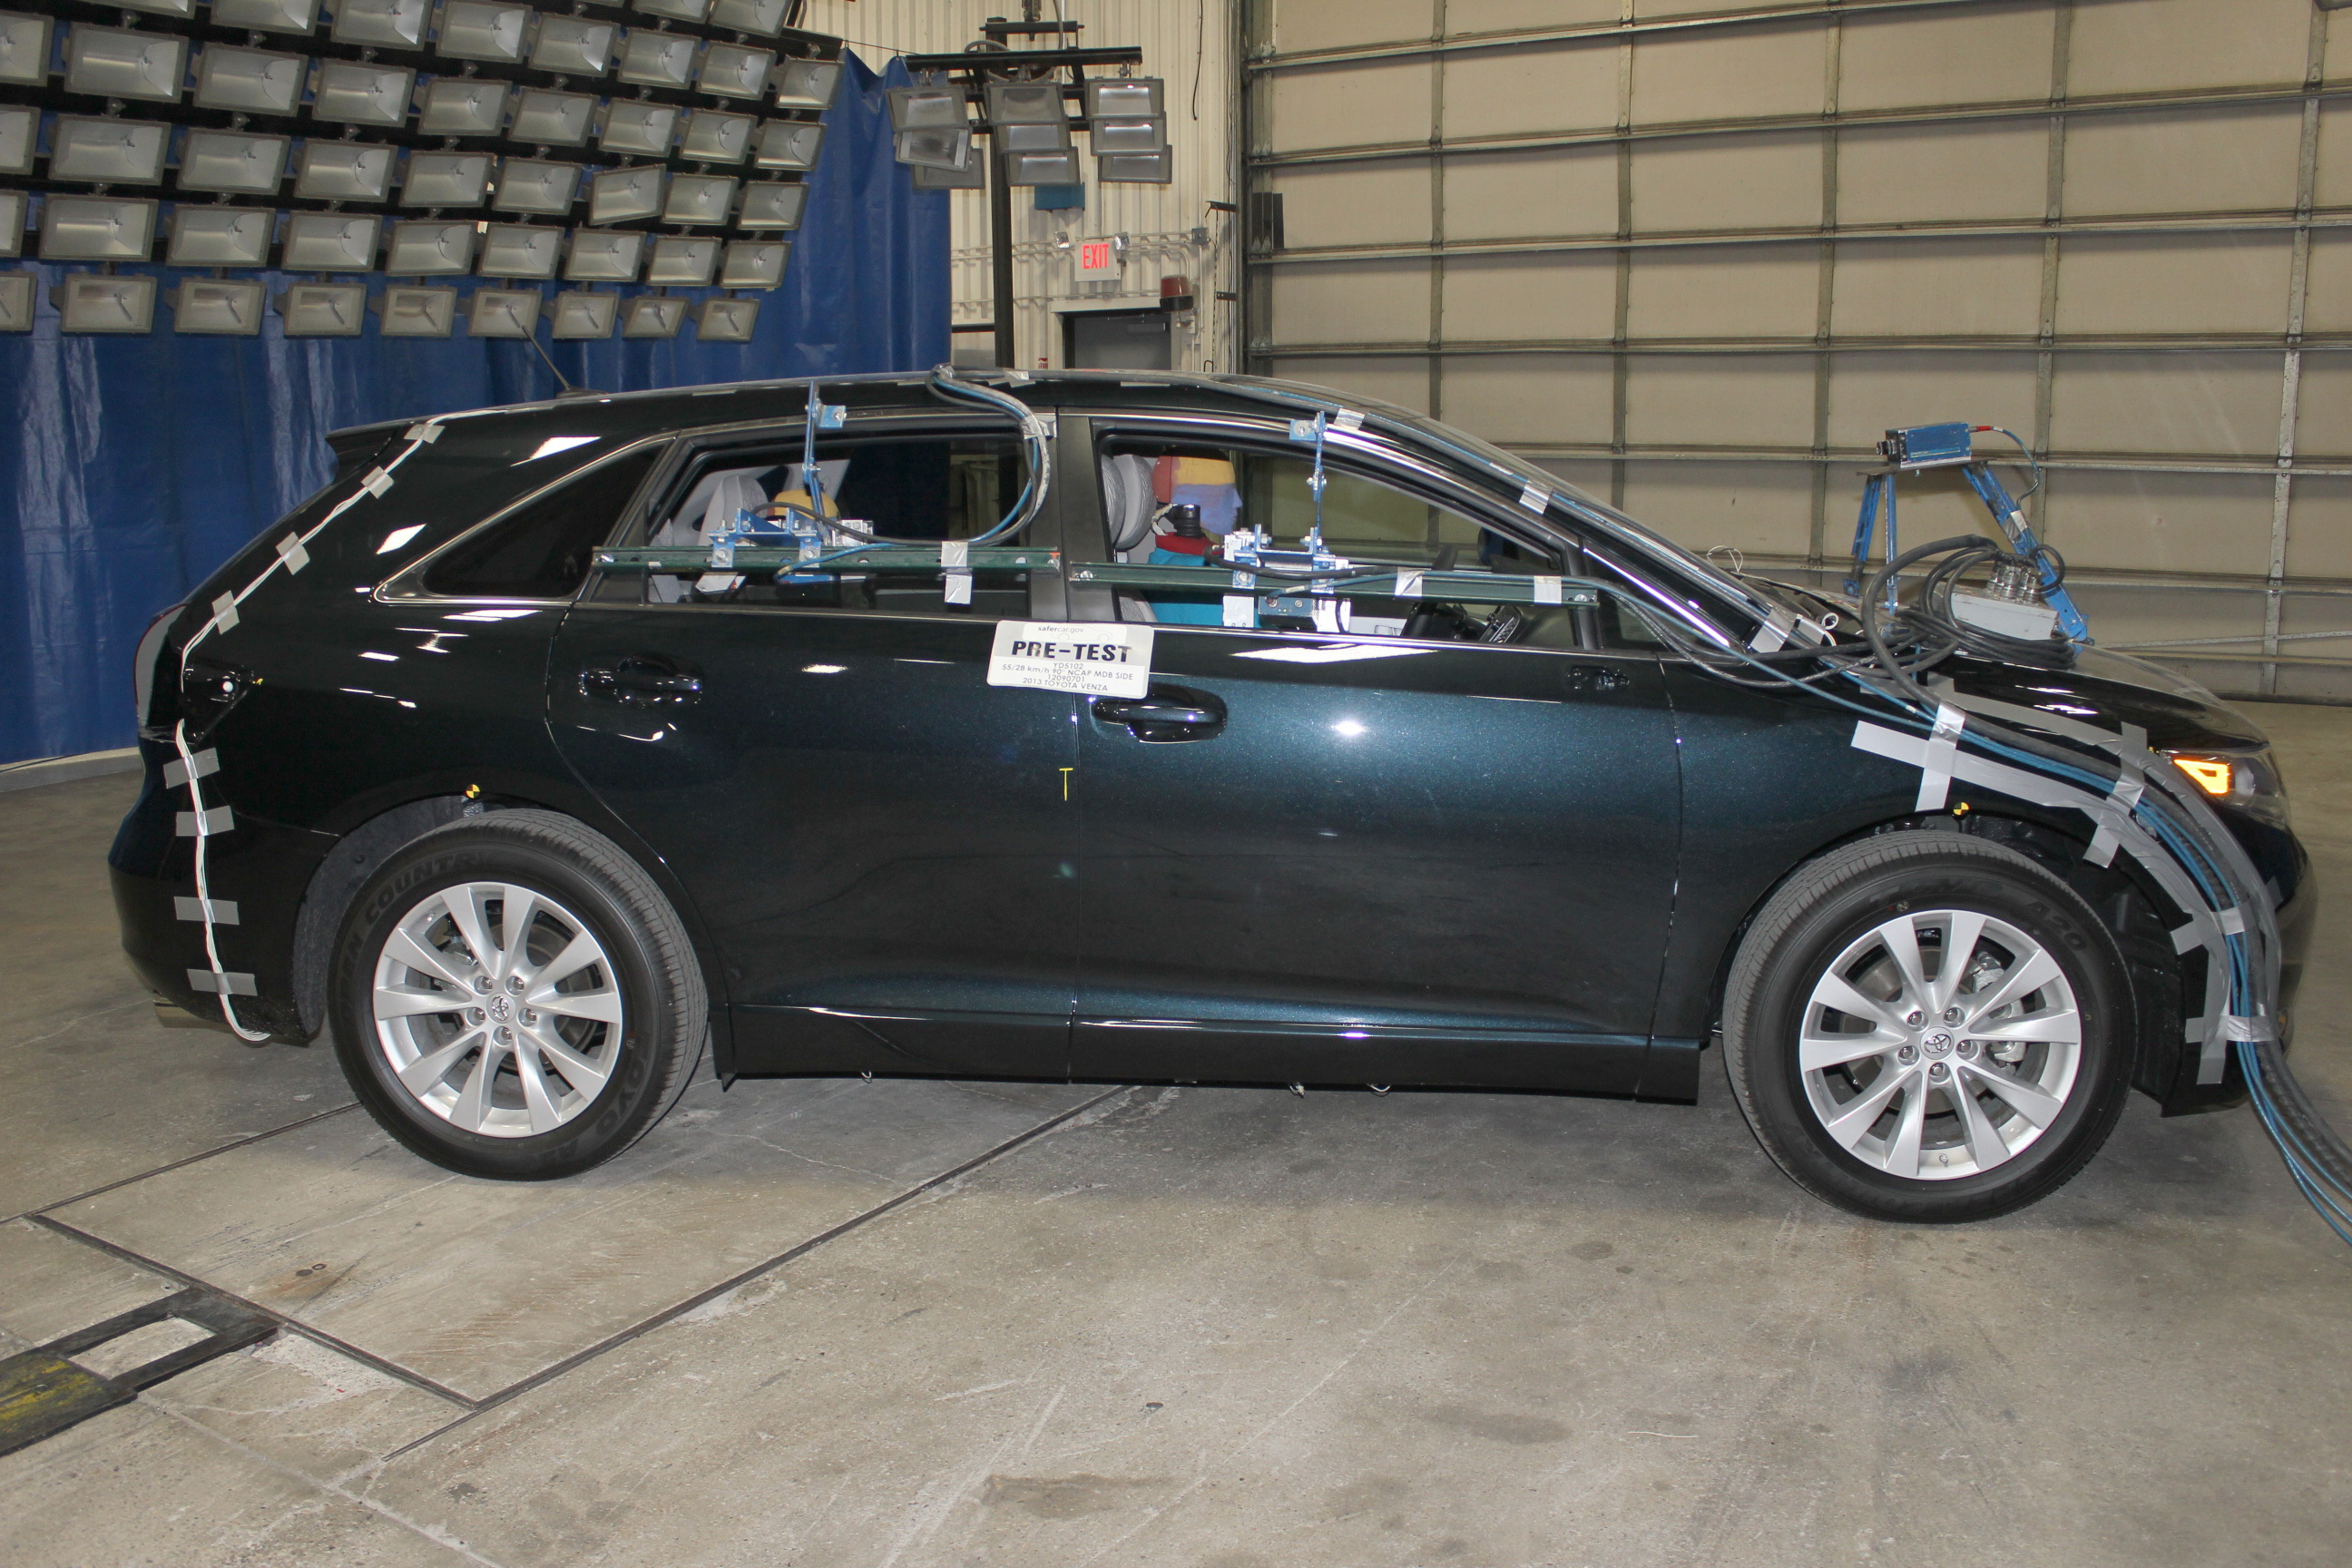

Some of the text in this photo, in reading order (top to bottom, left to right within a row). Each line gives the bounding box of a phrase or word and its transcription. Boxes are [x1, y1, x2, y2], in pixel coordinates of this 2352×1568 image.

[1082, 242, 1110, 270] EXIT
[1037, 625, 1085, 634] safercar.gov
[1011, 640, 1132, 662] PRE-TEST
[1002, 663, 1025, 671] 55/28
[1027, 665, 1050, 673] km/h
[1067, 669, 1092, 677] NCAP
[1093, 671, 1113, 679] MDB
[1115, 671, 1133, 681] SIDE
[1054, 662, 1083, 670] YD5102
[1023, 677, 1108, 691] 2013 TOYOTA VENZA
[1048, 673, 1085, 683] 12090701
